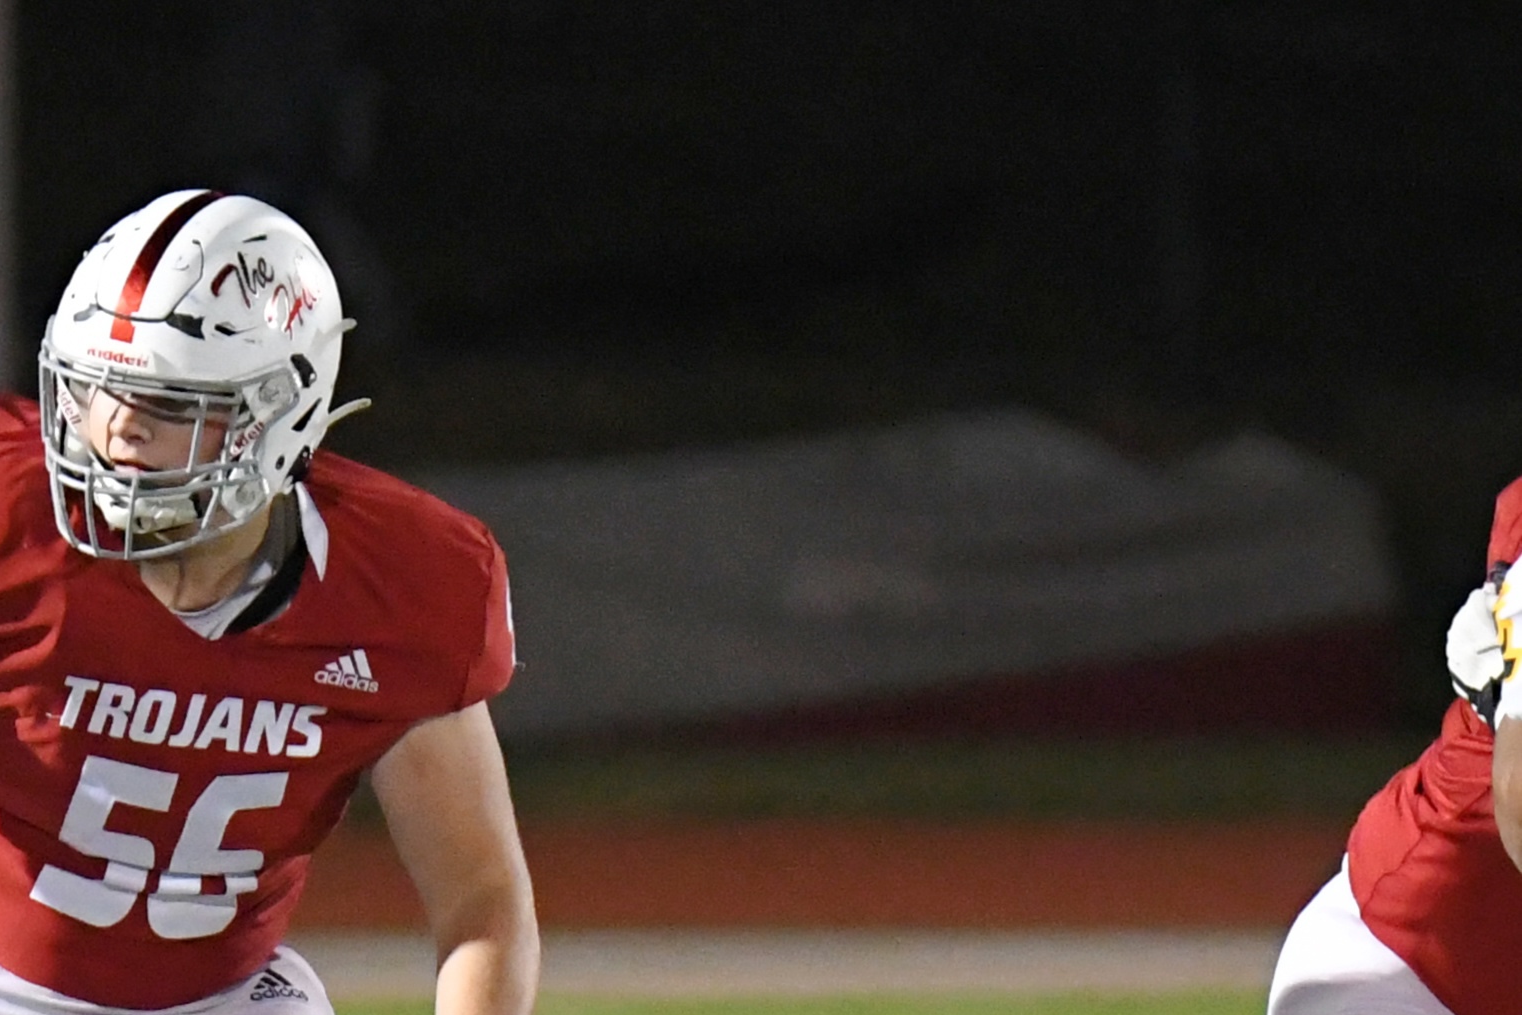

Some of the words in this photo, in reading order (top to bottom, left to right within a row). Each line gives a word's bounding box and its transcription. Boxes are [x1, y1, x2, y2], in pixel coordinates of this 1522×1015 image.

[210, 251, 275, 309] The
[59, 674, 327, 758] TROJANS
[314, 670, 379, 694] adidas
[31, 754, 289, 940] 56
